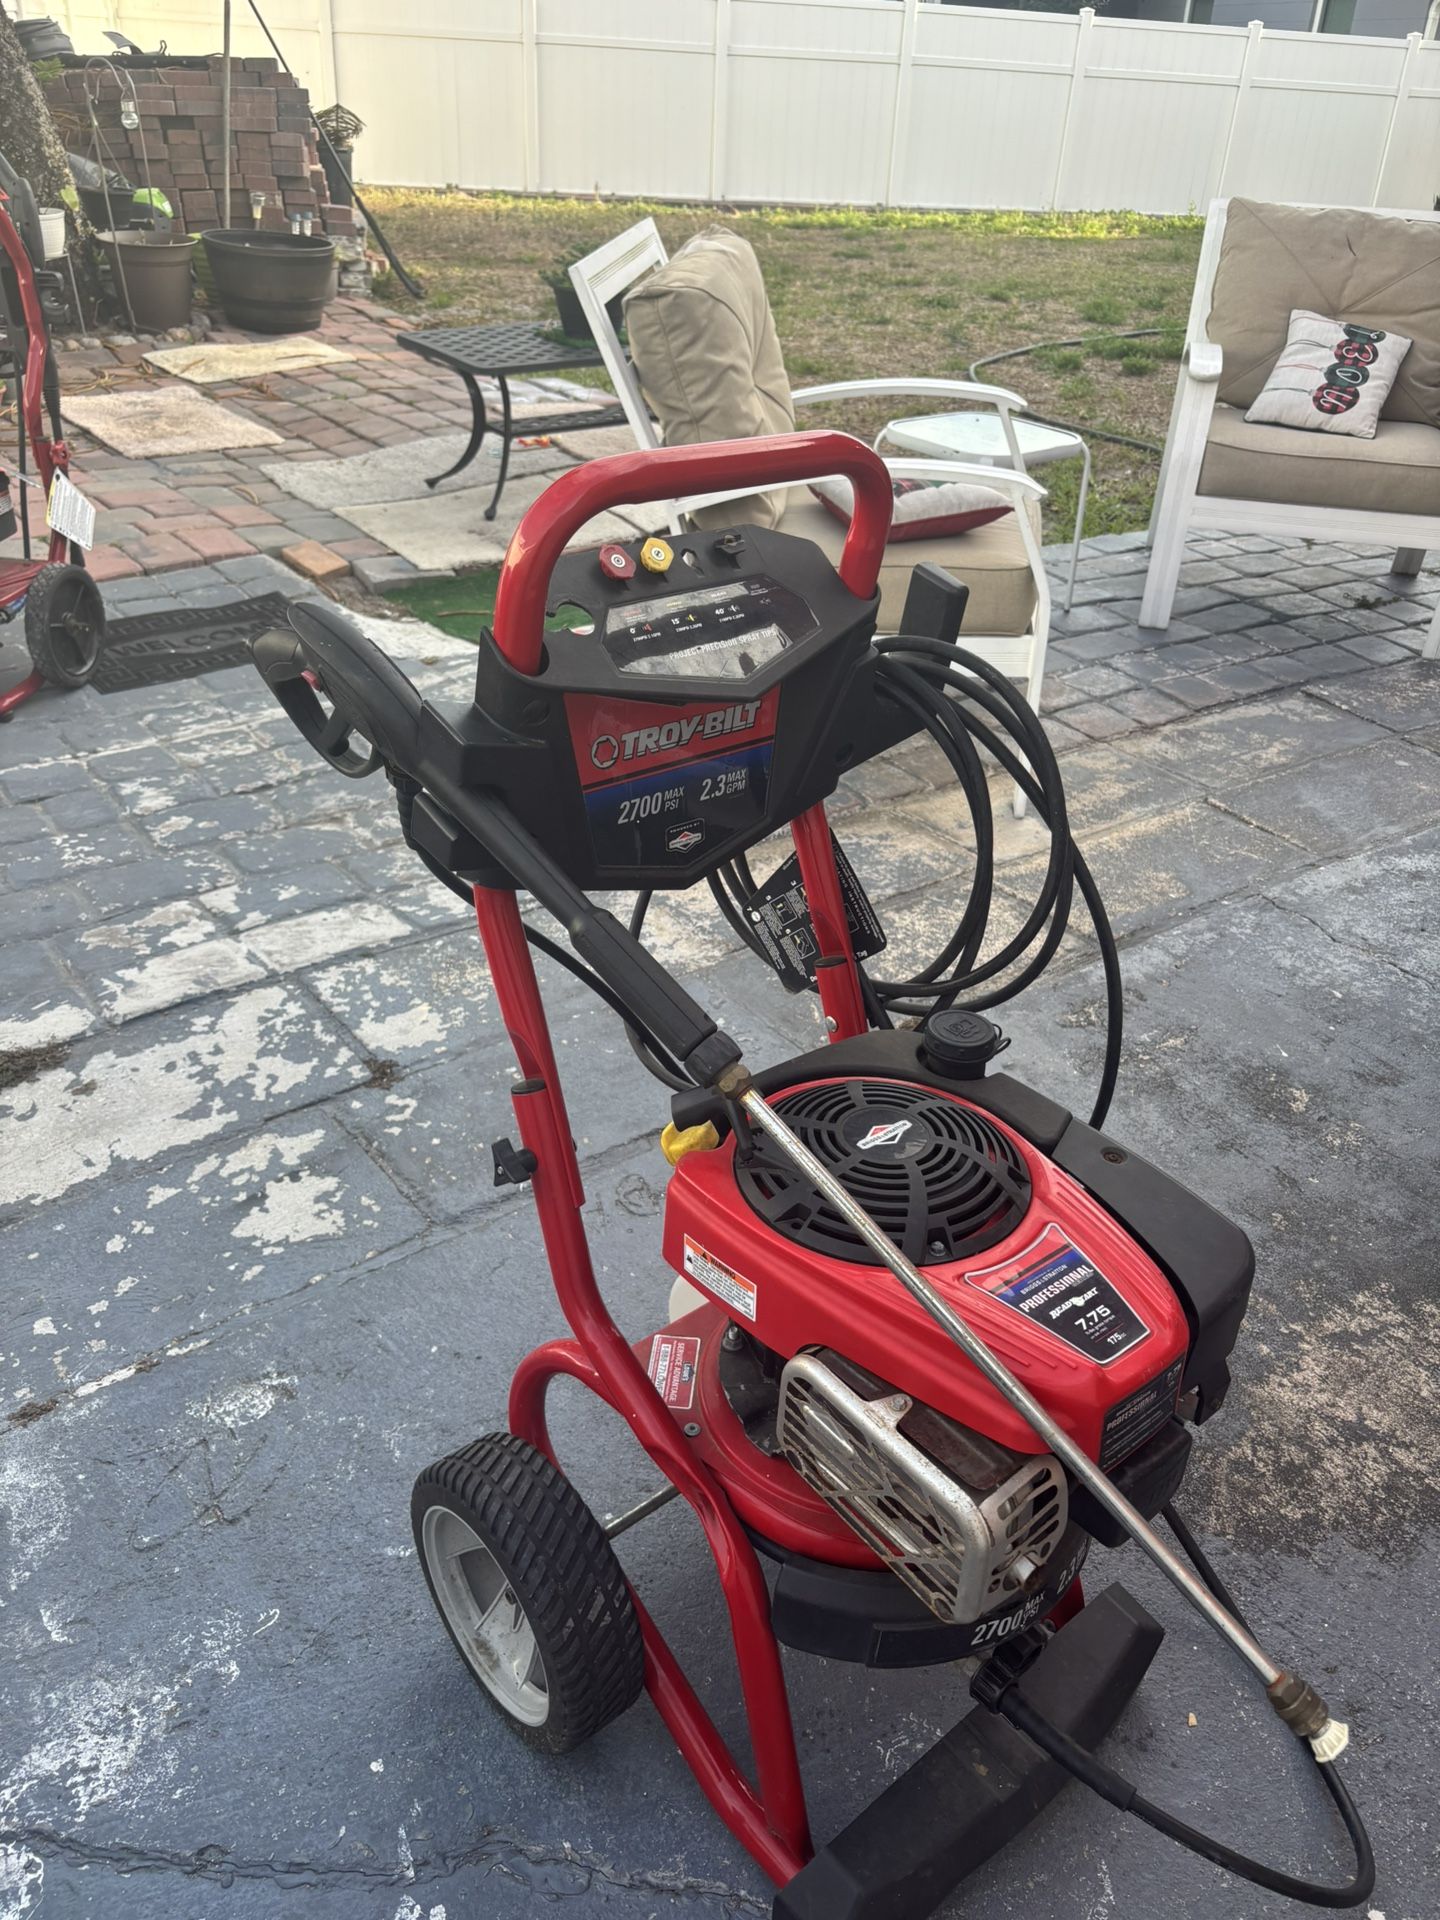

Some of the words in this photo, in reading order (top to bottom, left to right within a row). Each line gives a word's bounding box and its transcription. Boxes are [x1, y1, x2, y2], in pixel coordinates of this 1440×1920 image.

[110, 624, 264, 657] WELCOM
[669, 646, 700, 660] PROJECT
[700, 637, 738, 655] PRECISION
[739, 631, 761, 646] SPRAY
[761, 629, 777, 639] TIPS
[621, 700, 761, 760] TROY-BILT
[700, 774, 727, 801] 2.3
[727, 768, 747, 782] MAX
[726, 780, 746, 794] GPM
[617, 792, 662, 825] 2700
[664, 787, 685, 801] MAX
[664, 799, 680, 811] PSI
[1019, 1264, 1095, 1313] PROFESSIONAL
[1074, 1304, 1111, 1331] 7.75
[676, 1342, 685, 1366] SERVICE
[670, 1367, 681, 1402] ADVANTAGE
[970, 1608, 1023, 1646] 2700
[1025, 1592, 1045, 1610] MAX
